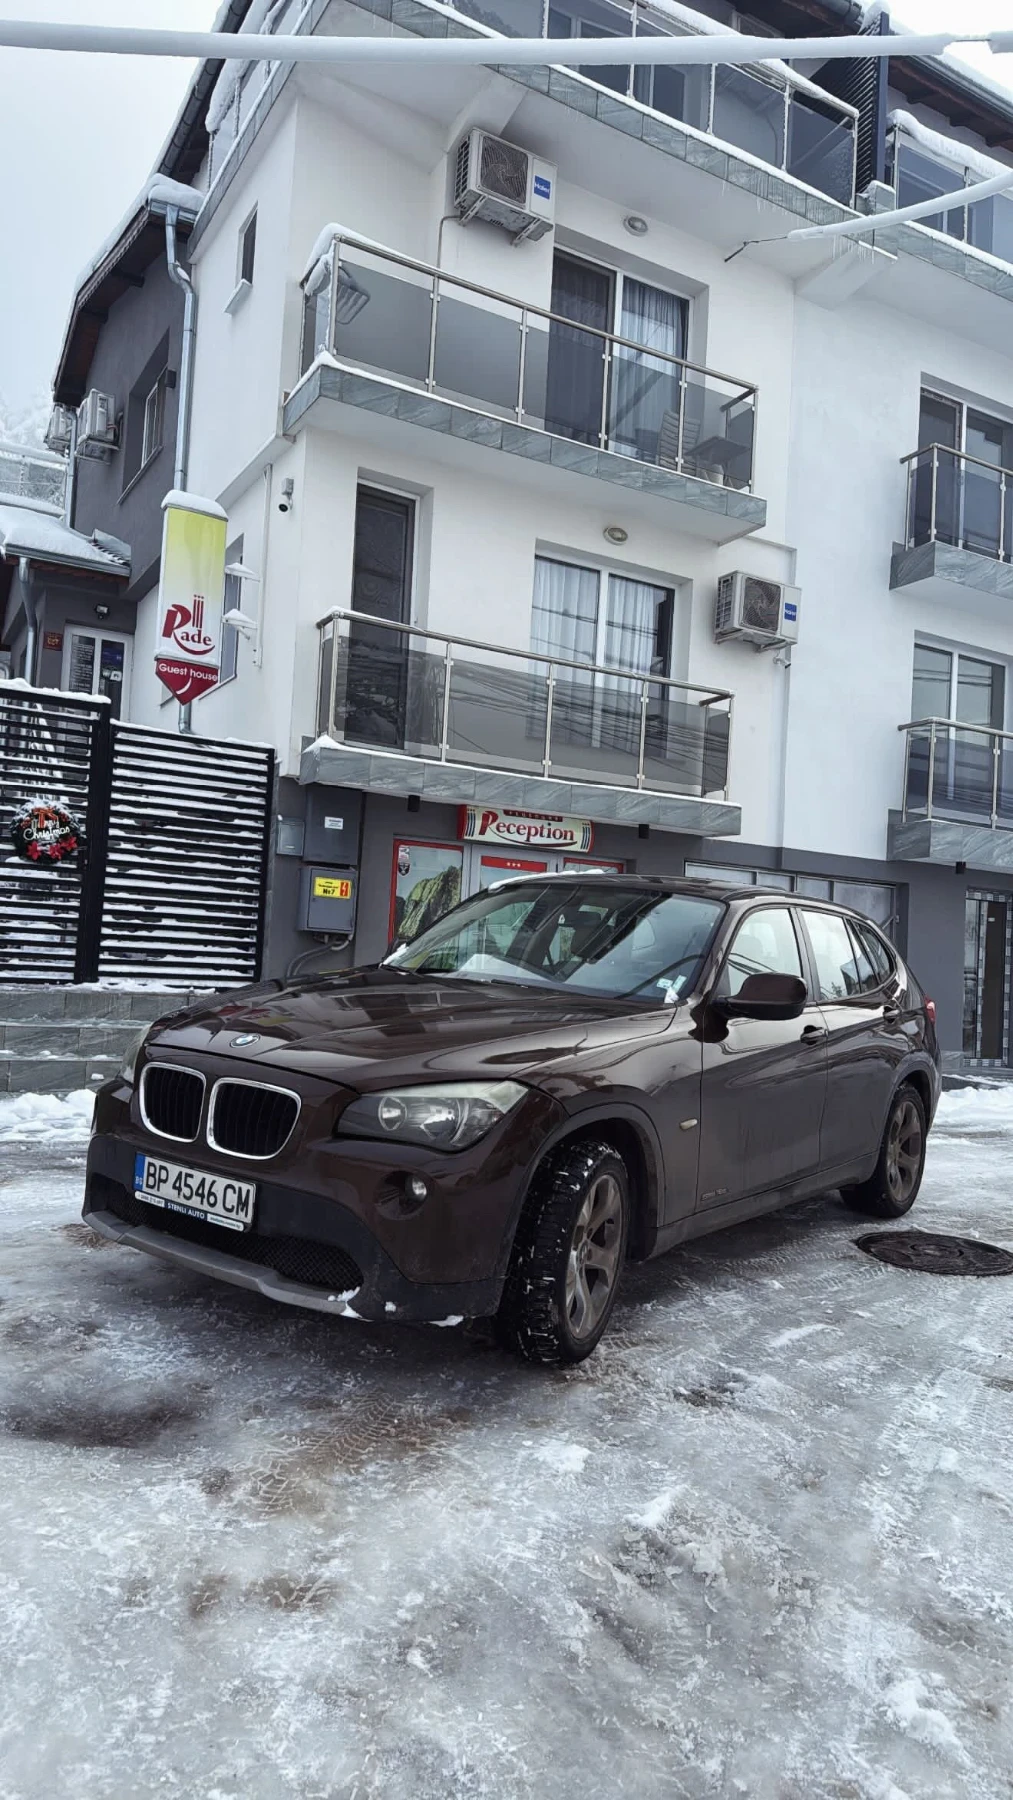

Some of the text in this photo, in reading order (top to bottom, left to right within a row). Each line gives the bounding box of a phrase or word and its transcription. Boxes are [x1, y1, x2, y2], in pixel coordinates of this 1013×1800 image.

[162, 603, 215, 655] Rade
[159, 663, 218, 682] Guest house
[479, 810, 577, 847] Reception
[145, 1162, 251, 1218] BP 4546 CM
[188, 1207, 205, 1220] AUTO
